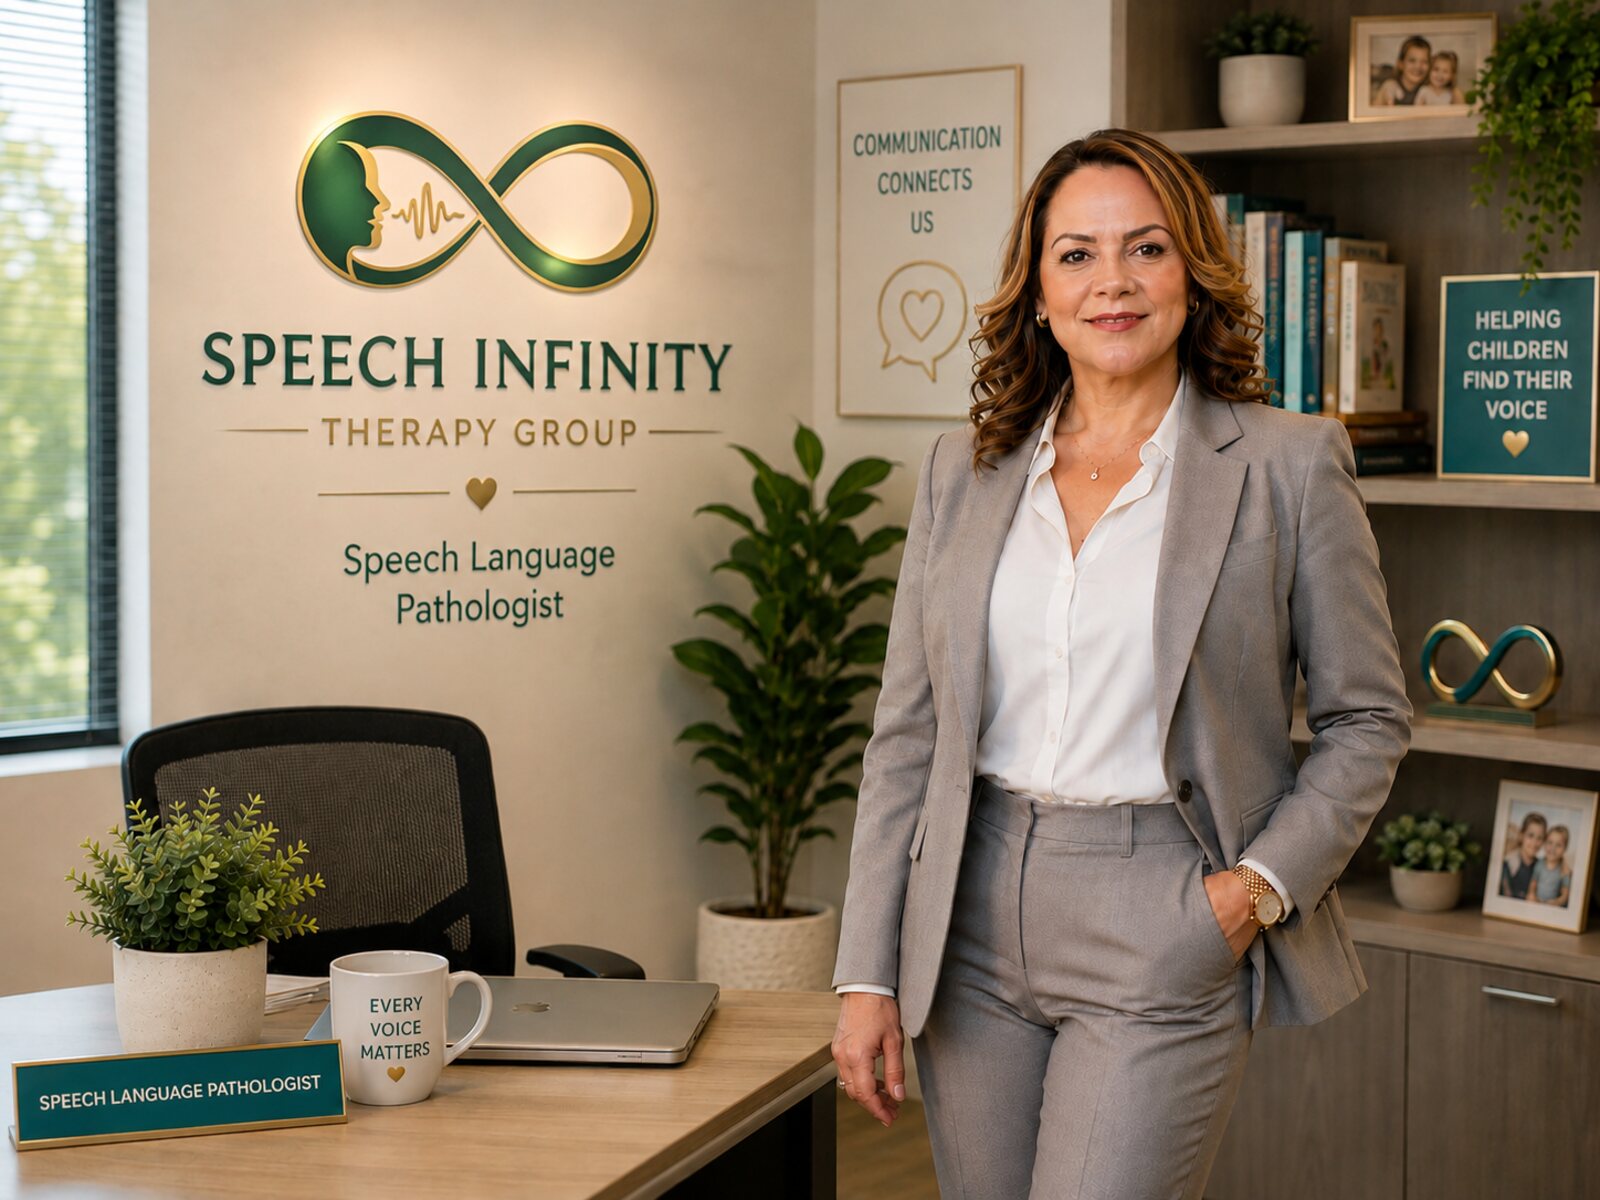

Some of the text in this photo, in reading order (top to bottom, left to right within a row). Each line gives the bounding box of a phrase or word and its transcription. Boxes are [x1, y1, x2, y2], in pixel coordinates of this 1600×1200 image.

[853, 126, 1001, 156] COMMUNICATION
[877, 168, 973, 196] CONNECTS
[910, 210, 934, 234] US
[1475, 309, 1561, 330] HELPING
[201, 331, 733, 392] SPEECH INFINITY
[1467, 340, 1568, 361] CHILDREN
[1463, 370, 1573, 390] FIND THEIR
[1485, 400, 1548, 420] VOICE
[321, 418, 637, 446] THERAPY GROUP
[343, 541, 616, 584] Speech Language
[397, 588, 564, 627] Pathologist
[369, 995, 423, 1013] EVERY
[370, 1019, 422, 1037] VOICE
[360, 1040, 431, 1061] MATTERS
[39, 1074, 321, 1111] SPEECH LANGUAGE PATHOLOGIST
